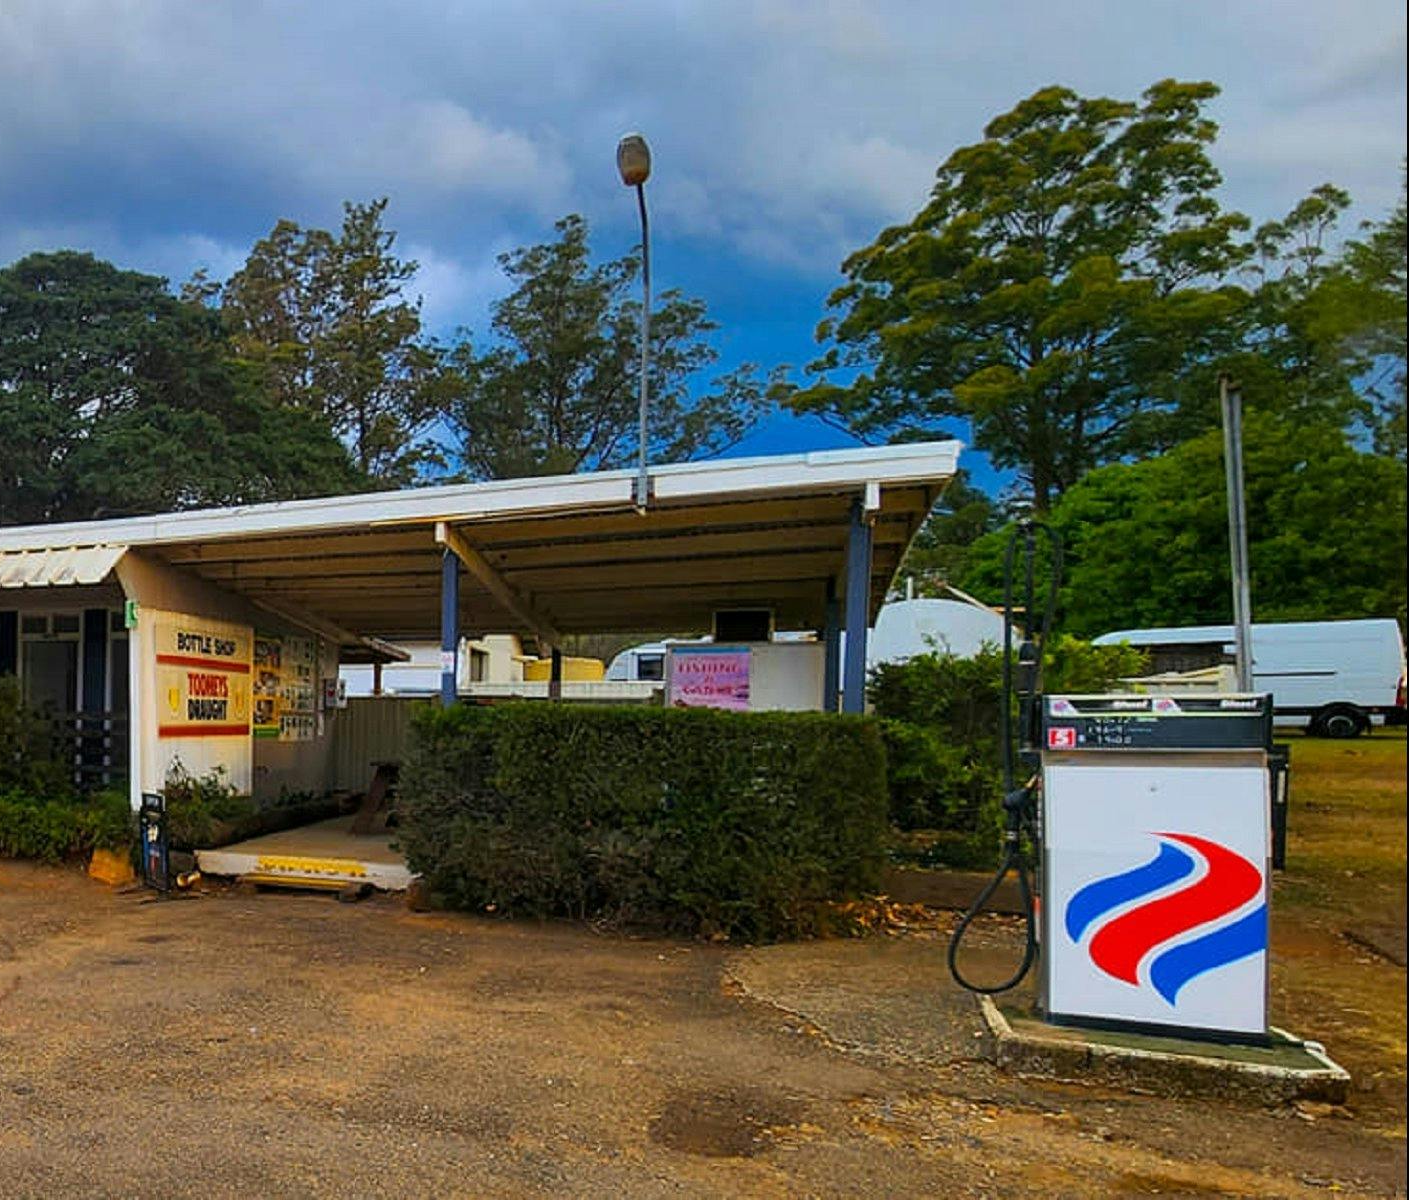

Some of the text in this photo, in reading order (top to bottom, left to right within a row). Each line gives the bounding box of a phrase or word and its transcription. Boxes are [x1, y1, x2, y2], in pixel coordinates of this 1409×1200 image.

[177, 632, 212, 654] BOTTLE
[214, 638, 236, 655] SHOP
[187, 672, 229, 698] TOOHEYS
